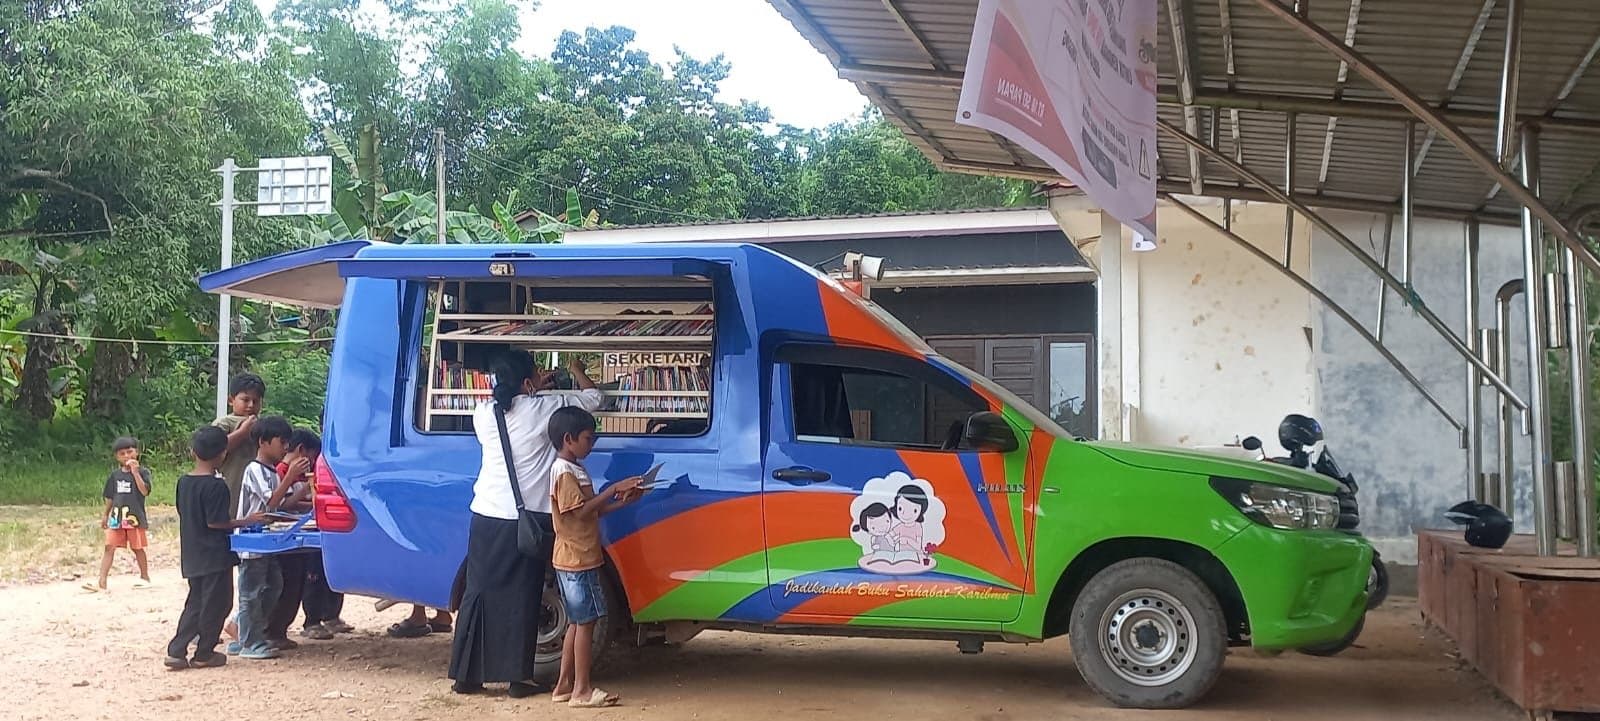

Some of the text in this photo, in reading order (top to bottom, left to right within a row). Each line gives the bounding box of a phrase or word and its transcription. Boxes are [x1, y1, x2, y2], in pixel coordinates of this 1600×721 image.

[784, 580, 1010, 600] Jadikanlah Buku Sahabat Karibmu
